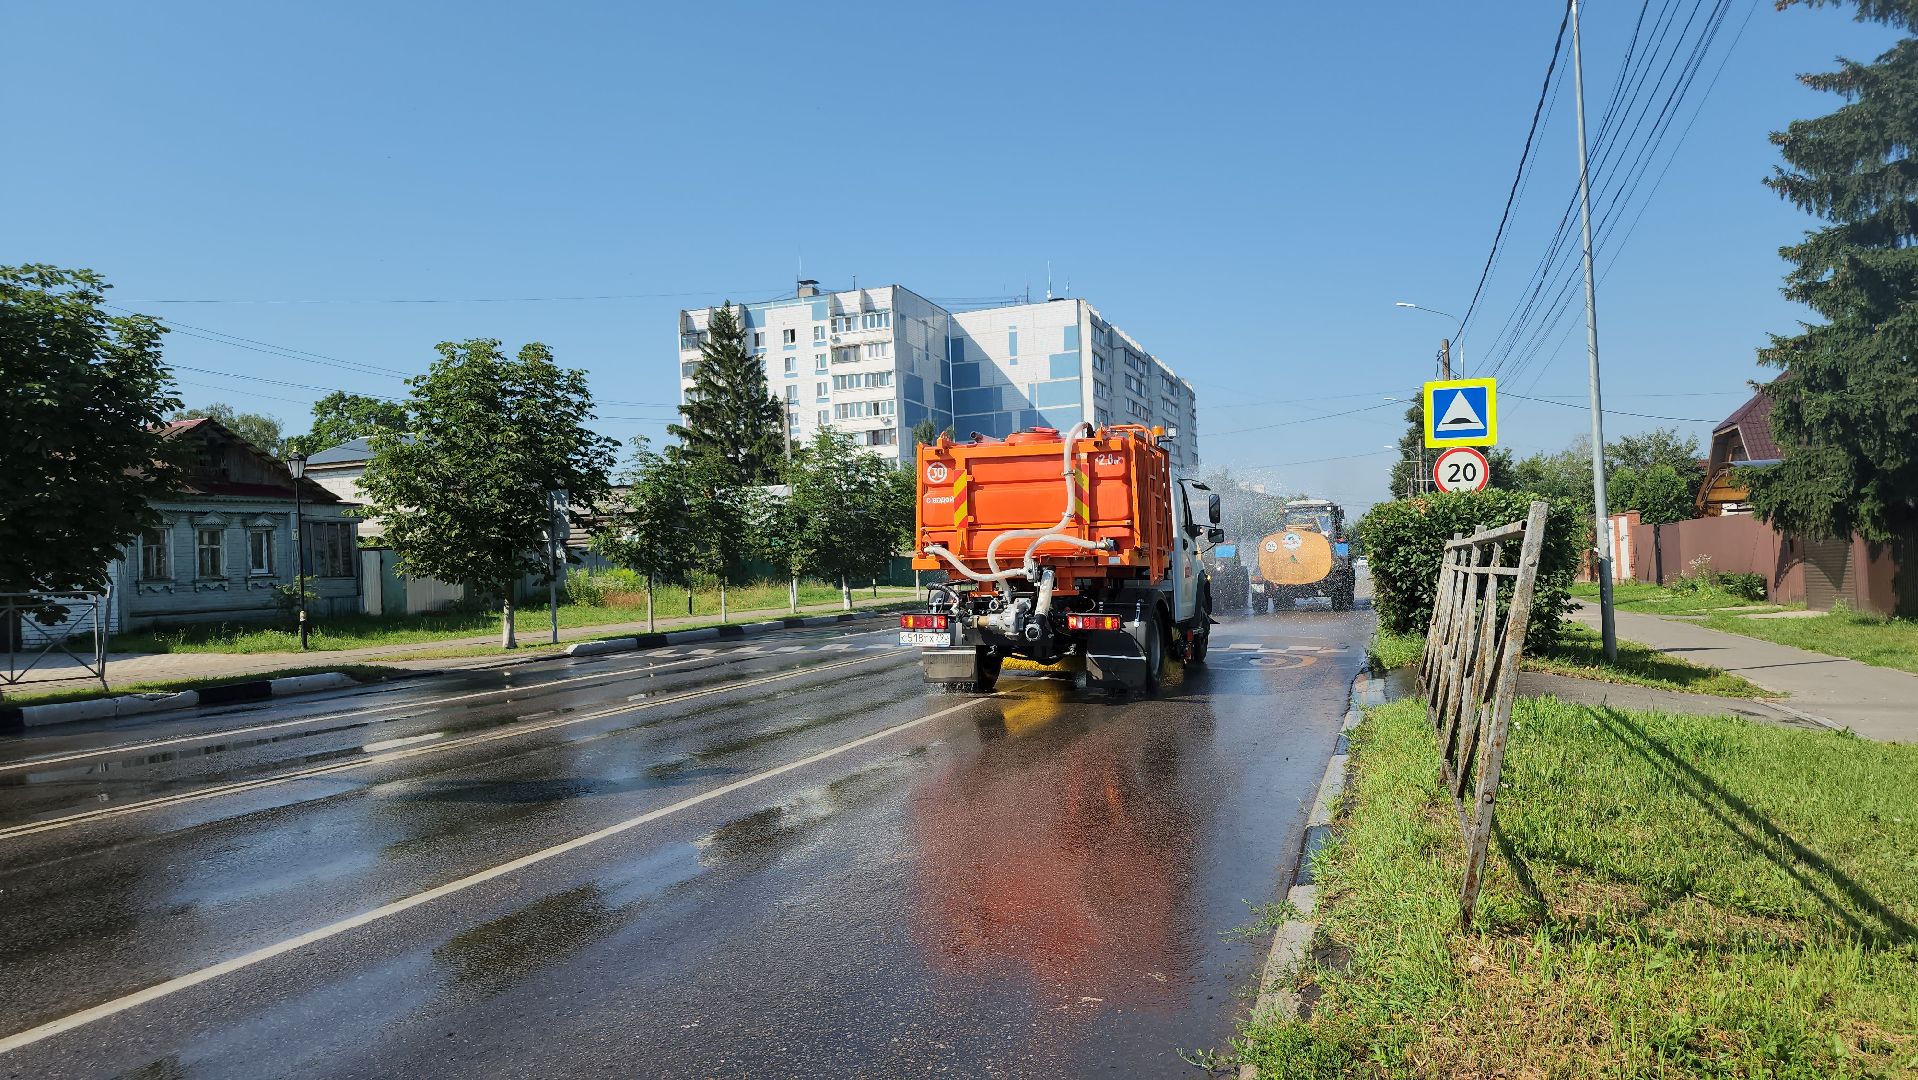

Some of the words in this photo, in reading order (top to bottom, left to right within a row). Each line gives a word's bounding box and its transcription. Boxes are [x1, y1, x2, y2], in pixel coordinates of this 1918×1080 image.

[931, 467, 944, 478] 30
[1448, 463, 1477, 482] 20
[932, 496, 955, 504] водой
